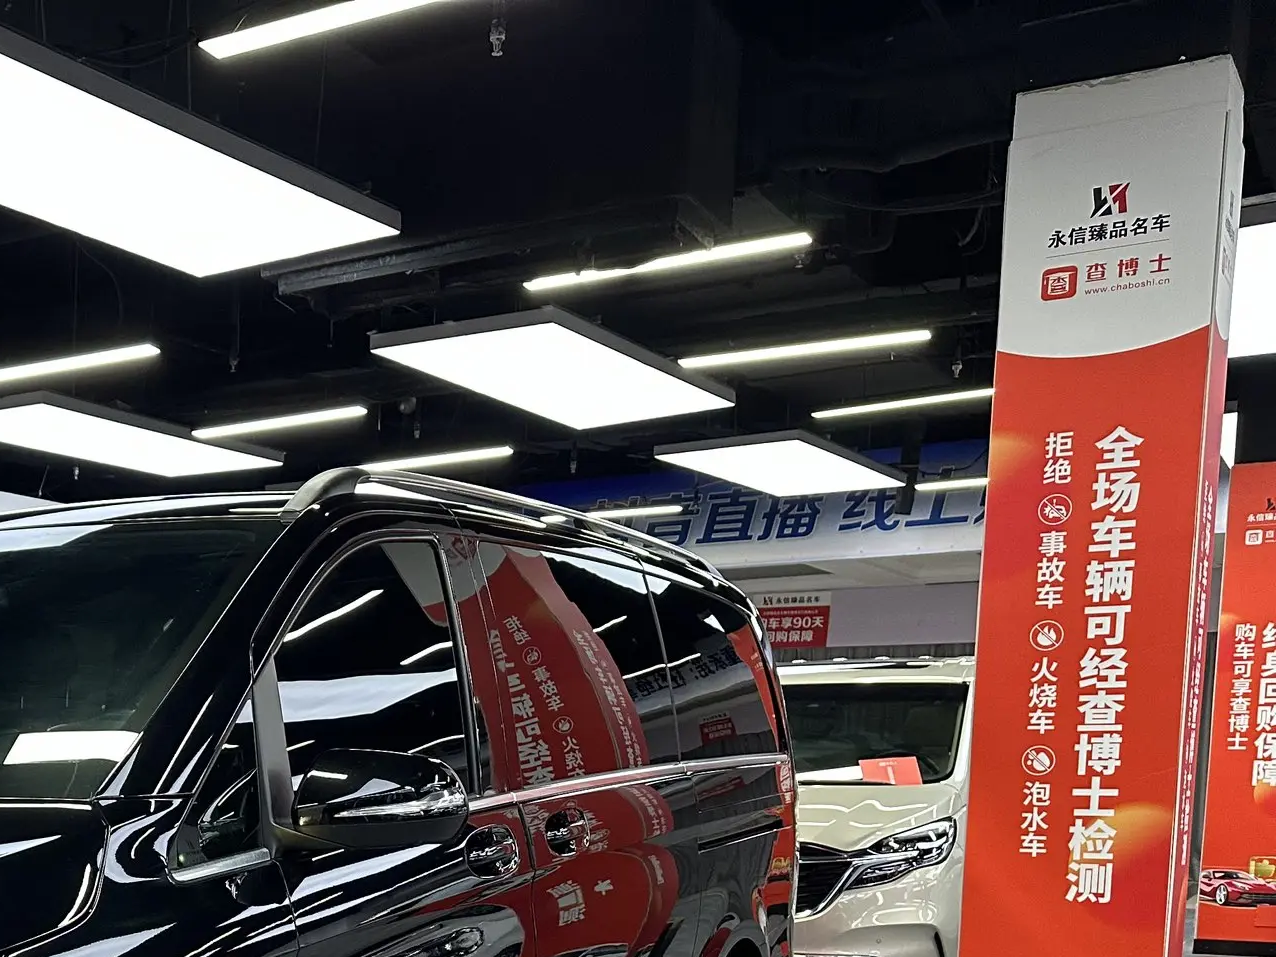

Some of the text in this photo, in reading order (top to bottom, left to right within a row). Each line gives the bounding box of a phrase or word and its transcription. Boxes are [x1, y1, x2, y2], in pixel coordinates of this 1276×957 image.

[1047, 213, 1172, 249] 永信臻品名车
[1084, 278, 1171, 296] www.chaboshi.cn
[838, 467, 983, 532] 线上
[1018, 430, 1074, 858] 拒绝 事故车 火烧车 泡水车
[1065, 425, 1145, 905] 全场车辆可经查博士检测
[1227, 623, 1256, 751] 购车可享查博士
